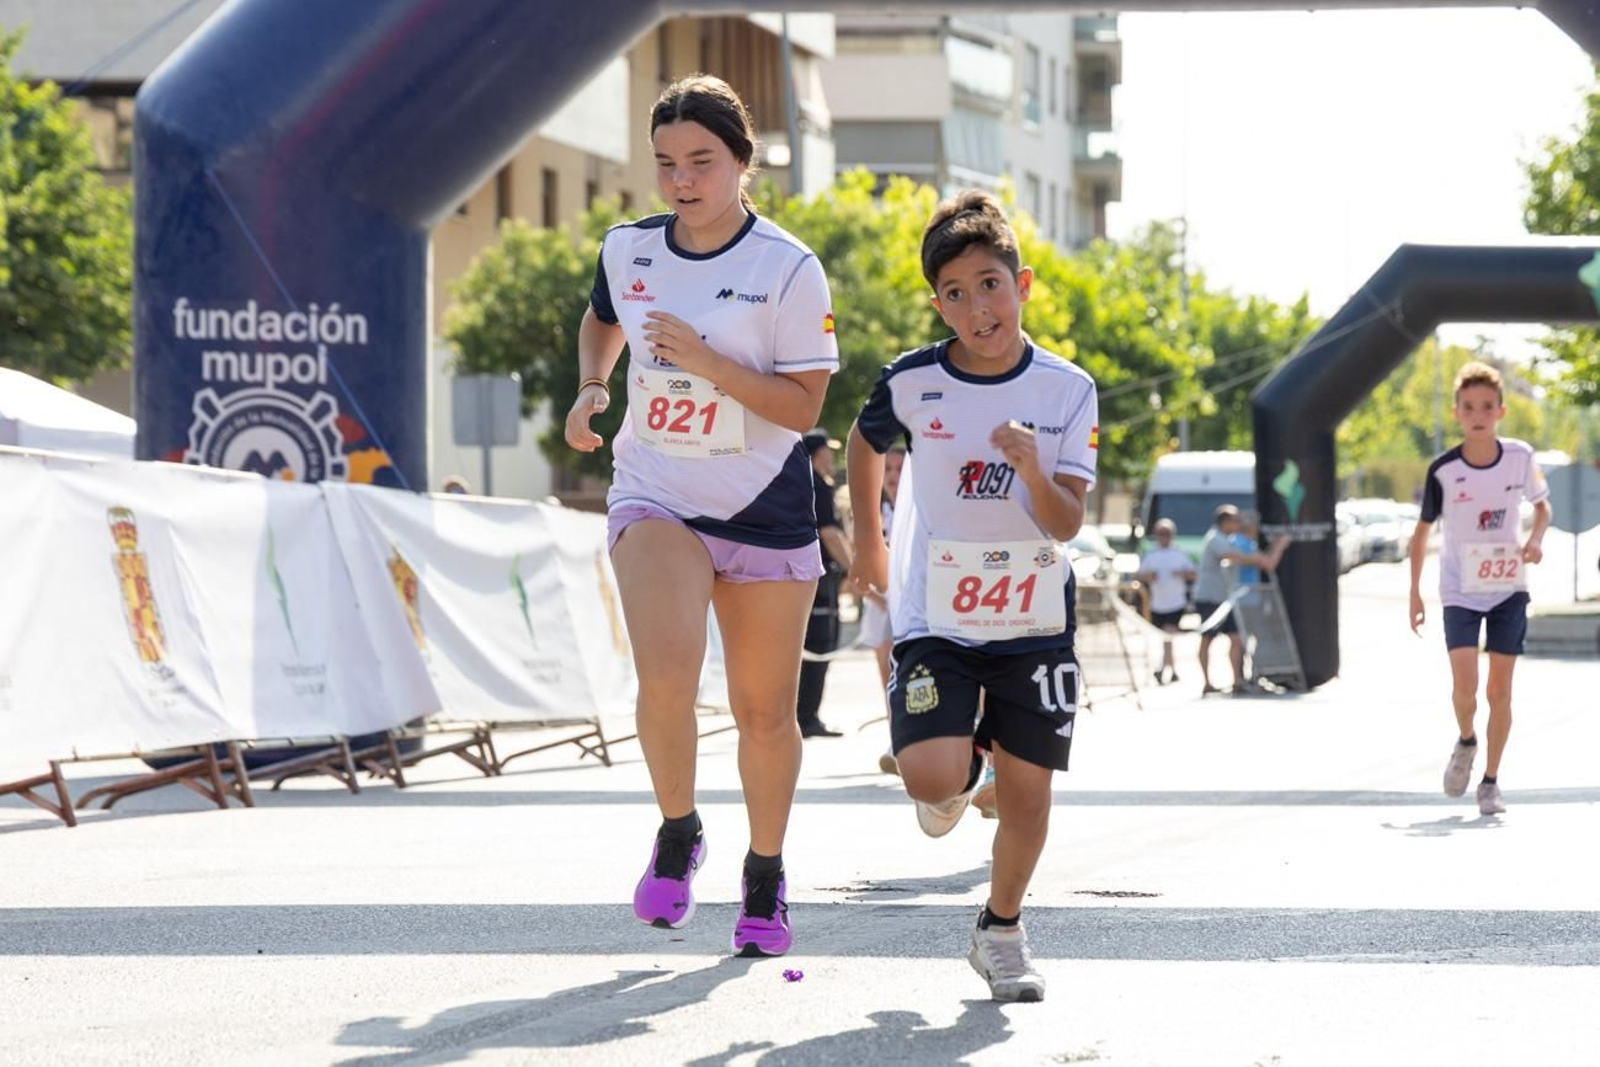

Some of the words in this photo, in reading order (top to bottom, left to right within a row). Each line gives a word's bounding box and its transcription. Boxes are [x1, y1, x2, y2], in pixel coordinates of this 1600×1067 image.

[621, 292, 656, 303] Santander
[737, 292, 768, 305] mupol
[173, 297, 368, 344] fundación
[202, 344, 328, 388] mupol
[647, 397, 719, 435] 821
[1039, 425, 1066, 436] mupo
[1477, 559, 1518, 579] 832
[952, 573, 1037, 614] 841
[1031, 661, 1081, 713] 10
